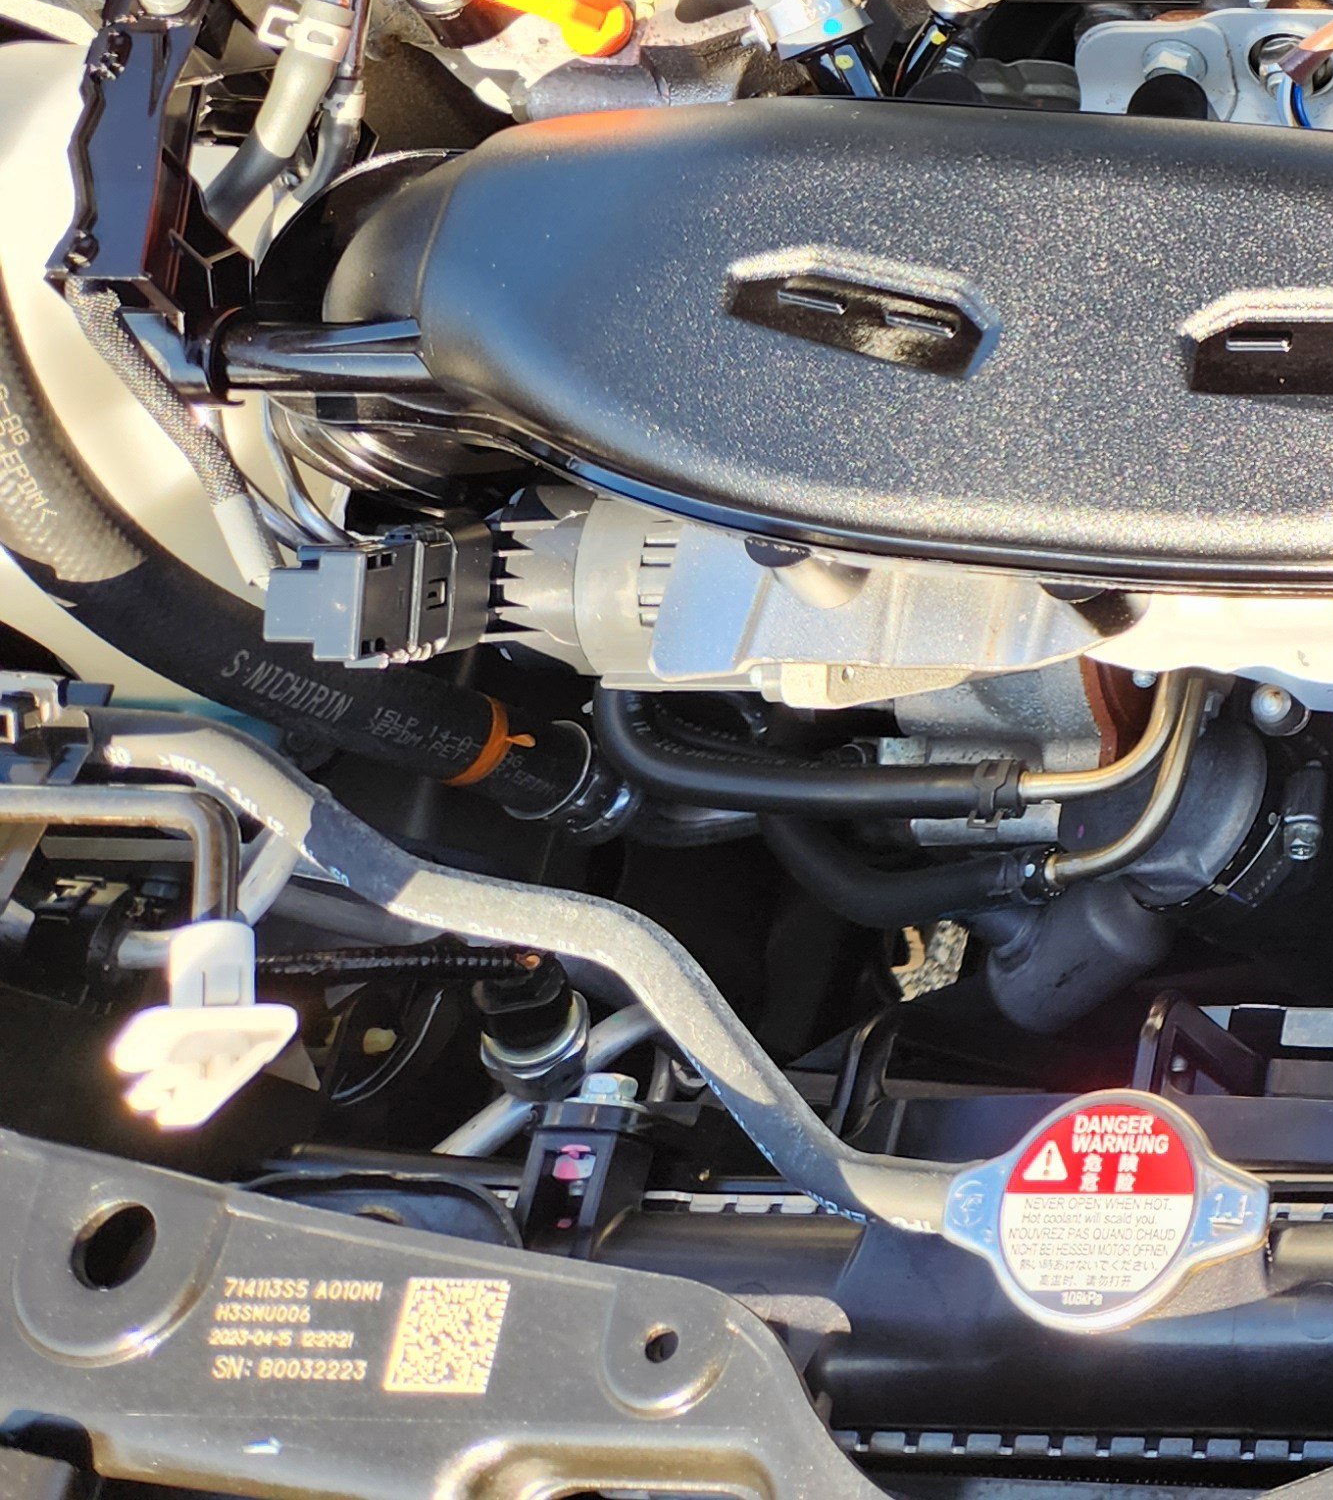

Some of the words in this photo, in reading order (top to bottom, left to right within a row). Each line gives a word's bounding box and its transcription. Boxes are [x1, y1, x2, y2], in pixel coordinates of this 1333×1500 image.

[1073, 1114, 1155, 1134] DANGER
[1072, 1134, 1169, 1154] WARNUNG
[1024, 1197, 1065, 1210] NEVER
[1068, 1197, 1101, 1210] OPEN
[1105, 1197, 1141, 1210] WHEN
[1143, 1198, 1172, 1211] HOT.
[1021, 1212, 1041, 1224] Hot
[1043, 1212, 1082, 1224] coolant
[1104, 1212, 1132, 1225] scald
[1067, 1228, 1090, 1240] PAS
[1093, 1228, 1133, 1241] QUAND
[1136, 1228, 1176, 1241] CHAUD
[1098, 1243, 1131, 1257] MOTOR
[209, 1328, 293, 1346] 2023-04-15
